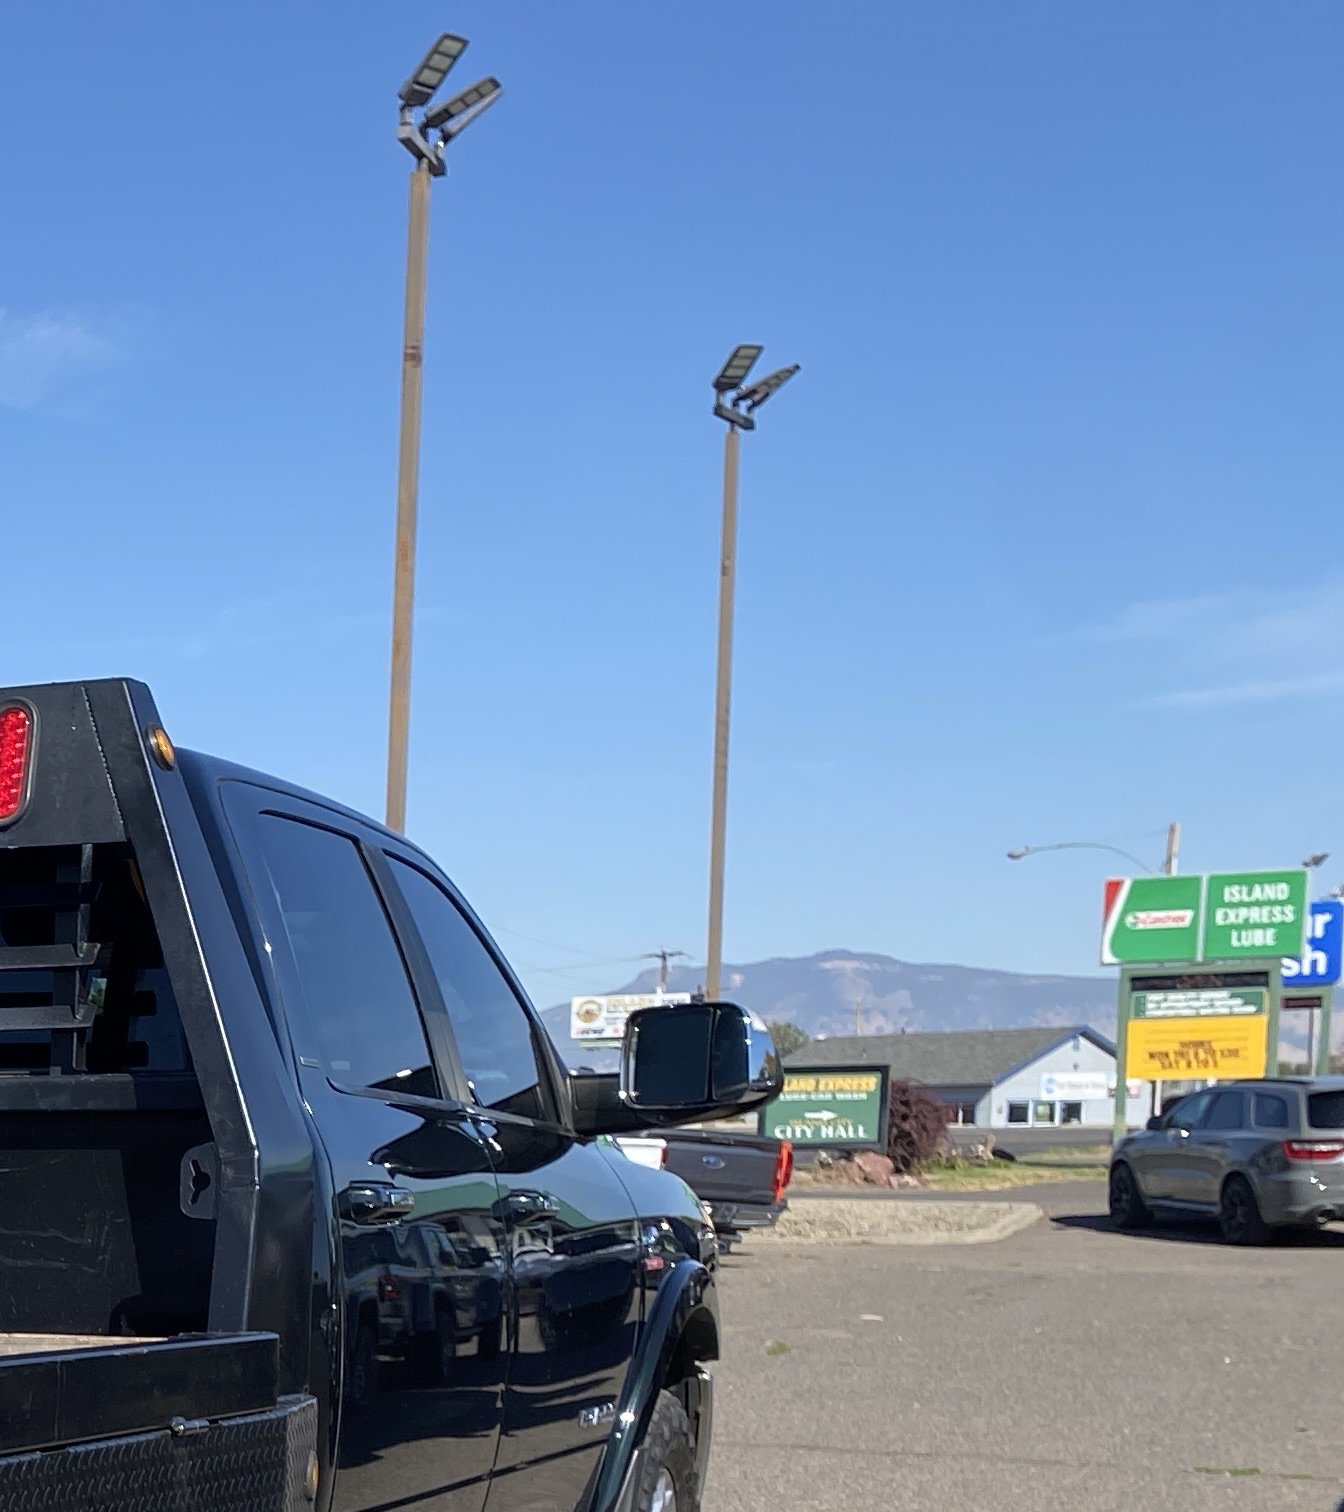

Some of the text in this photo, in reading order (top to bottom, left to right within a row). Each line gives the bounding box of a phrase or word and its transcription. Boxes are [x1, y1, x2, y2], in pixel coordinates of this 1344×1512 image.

[1223, 882, 1290, 903] ISLAND
[1215, 904, 1295, 926] EXPRESS
[1230, 928, 1277, 948] LUBE
[774, 1124, 867, 1139] CITY HALL
